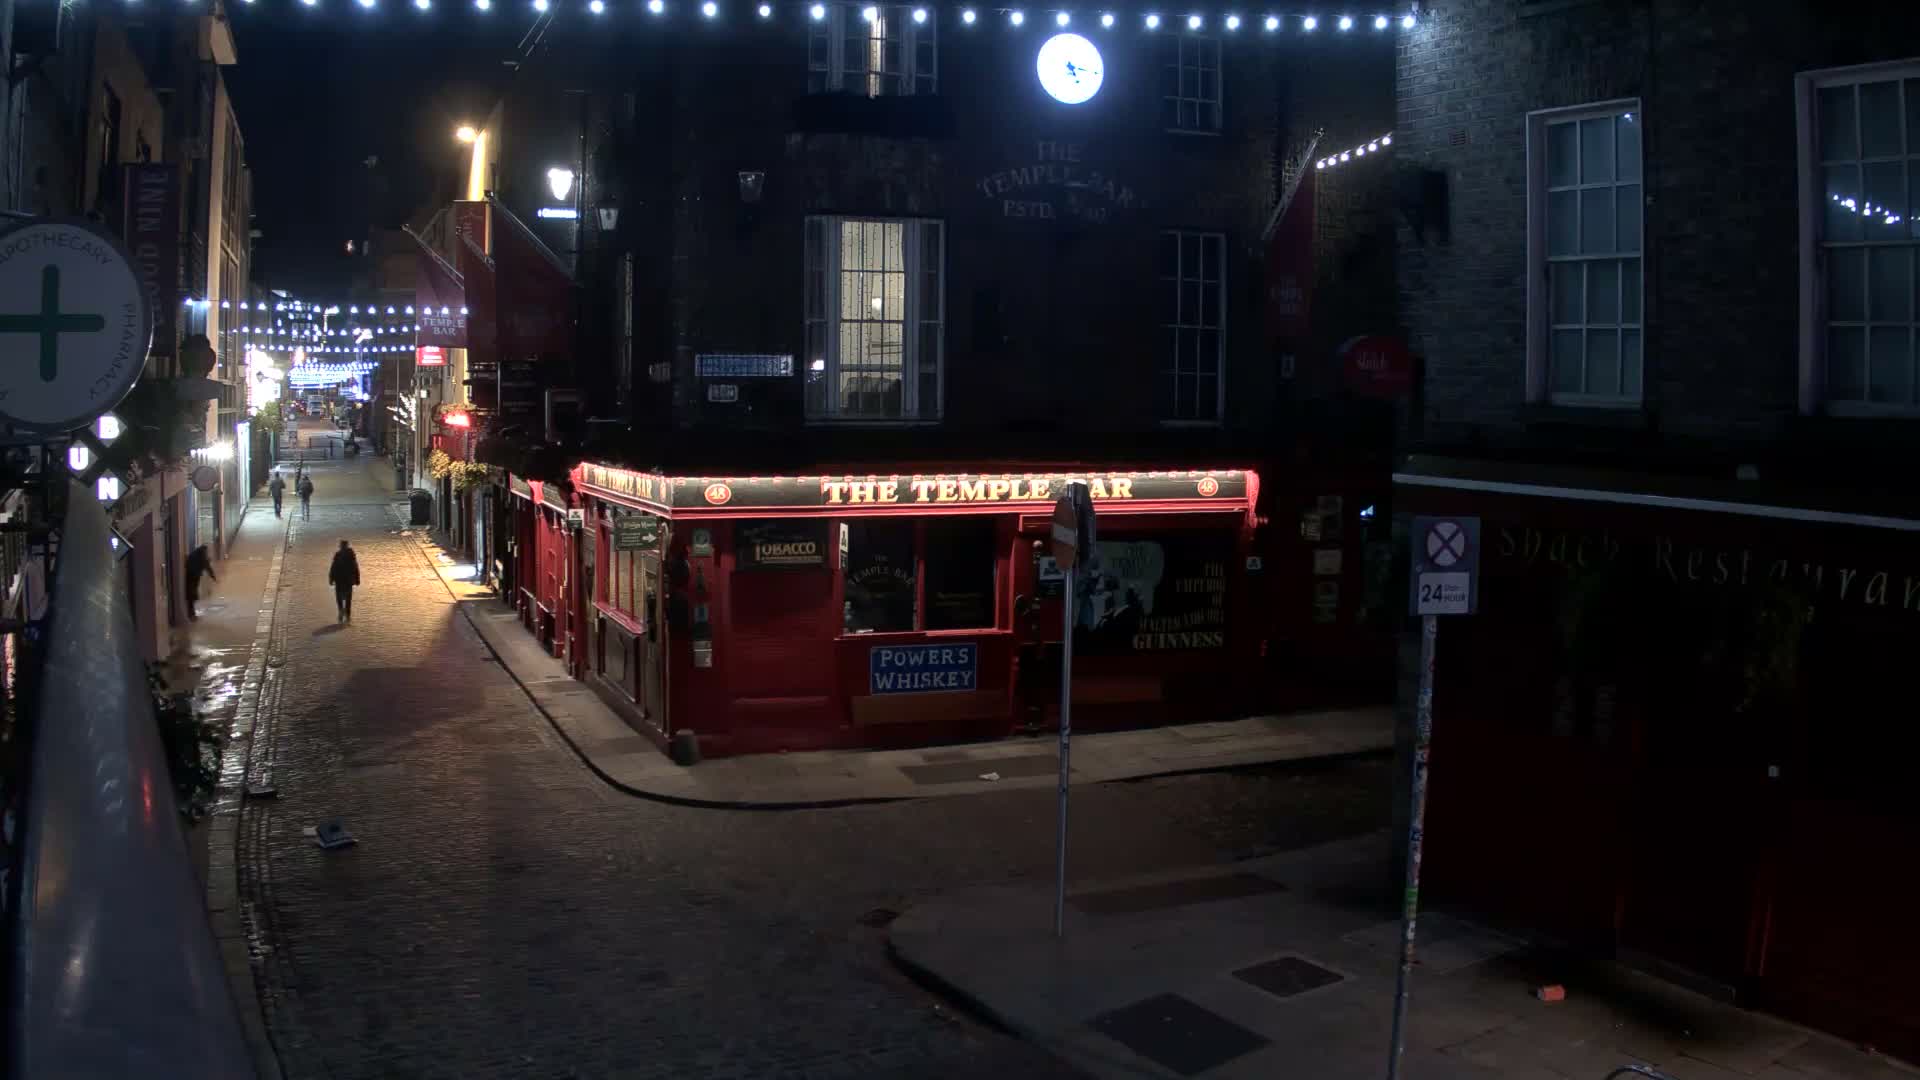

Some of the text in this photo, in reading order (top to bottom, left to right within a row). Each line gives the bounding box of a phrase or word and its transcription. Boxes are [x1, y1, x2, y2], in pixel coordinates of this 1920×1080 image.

[423, 317, 465, 329] TEMPLE
[433, 327, 457, 336] BAR
[636, 476, 652, 499] BAR
[823, 477, 1133, 503] THE TEMPLE AR
[1421, 584, 1442, 602] 24
[1132, 631, 1224, 649] GUINNESS
[874, 670, 974, 690] WHISKEY
